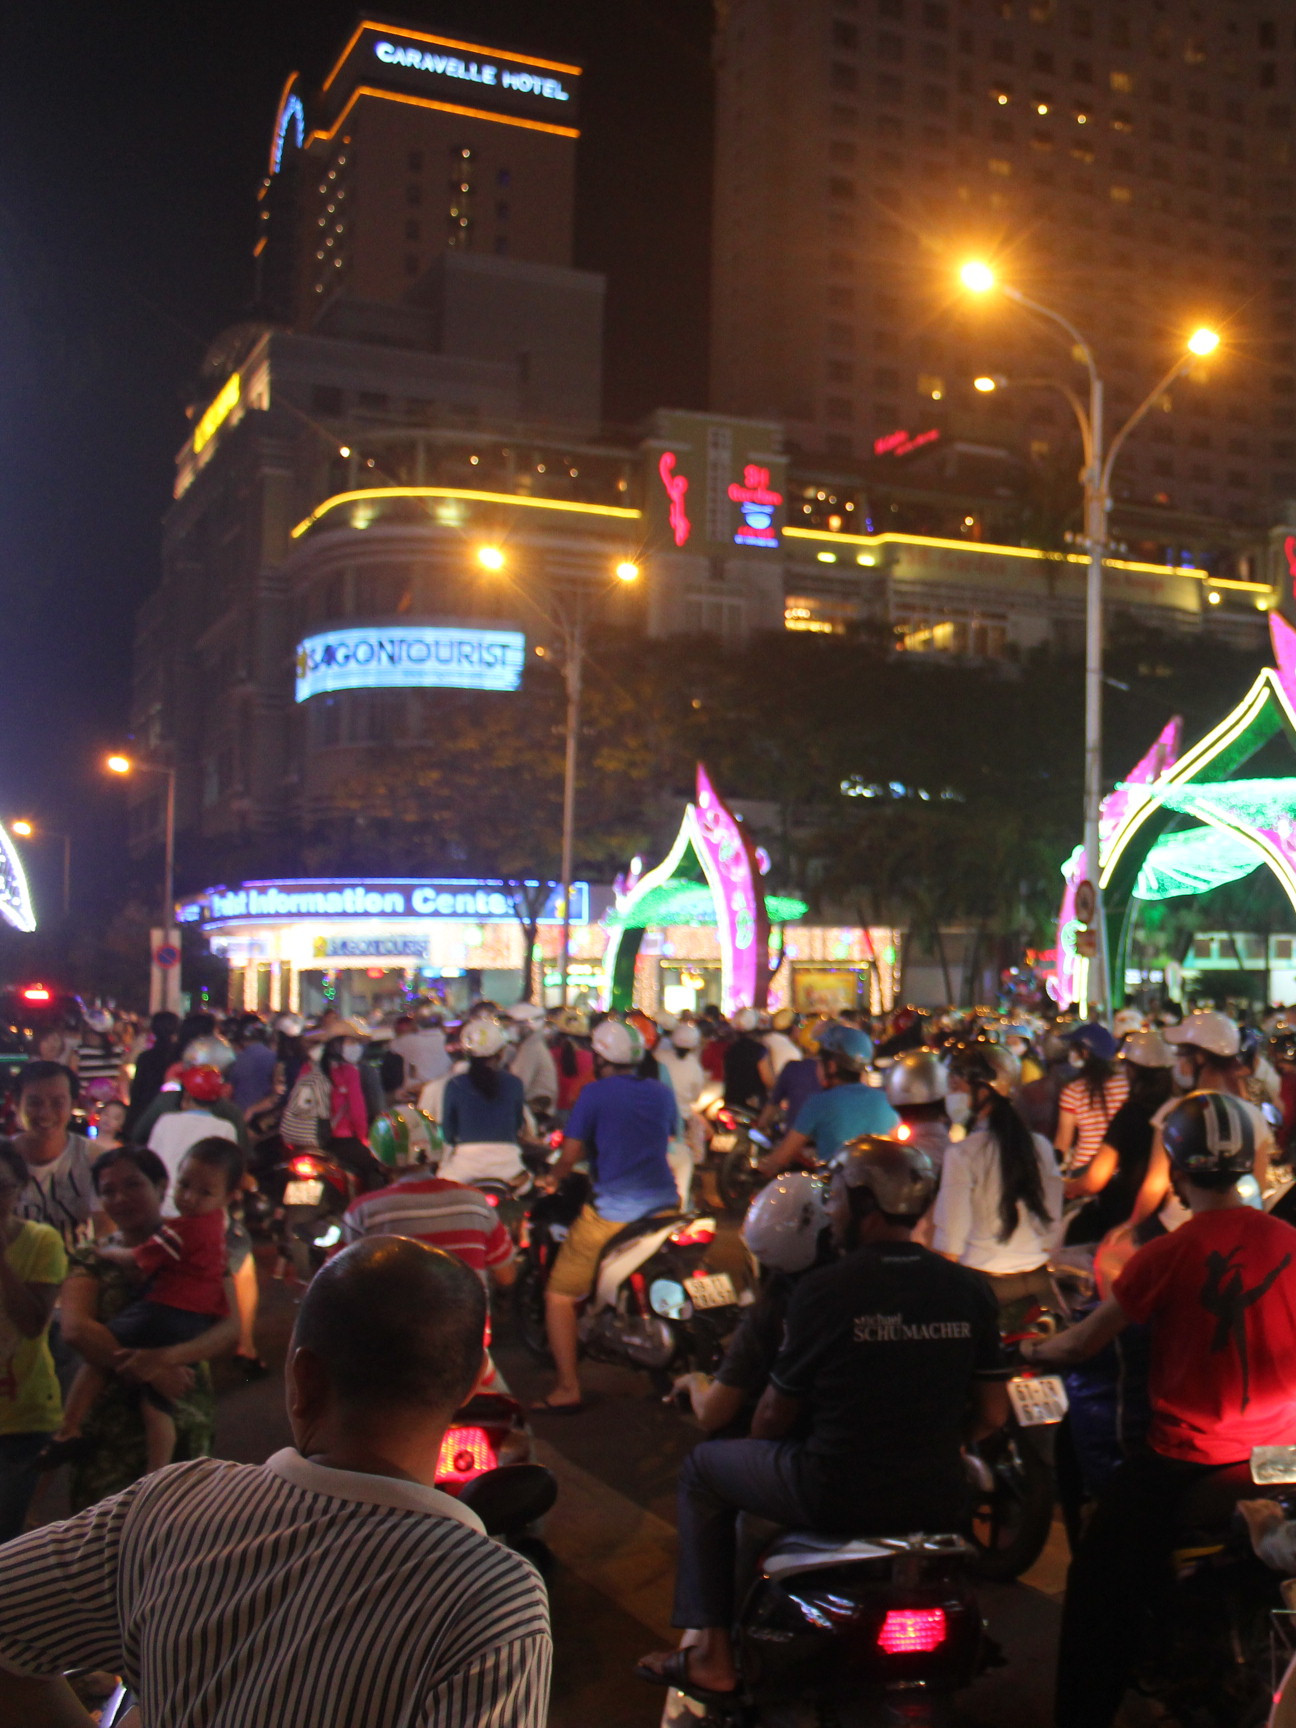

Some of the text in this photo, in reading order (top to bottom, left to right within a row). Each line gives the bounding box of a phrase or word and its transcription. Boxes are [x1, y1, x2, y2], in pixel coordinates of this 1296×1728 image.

[374, 41, 569, 101] CARAVELLE HOTEL
[249, 887, 405, 915] Information
[854, 1321, 972, 1343] SCHUMACHER
